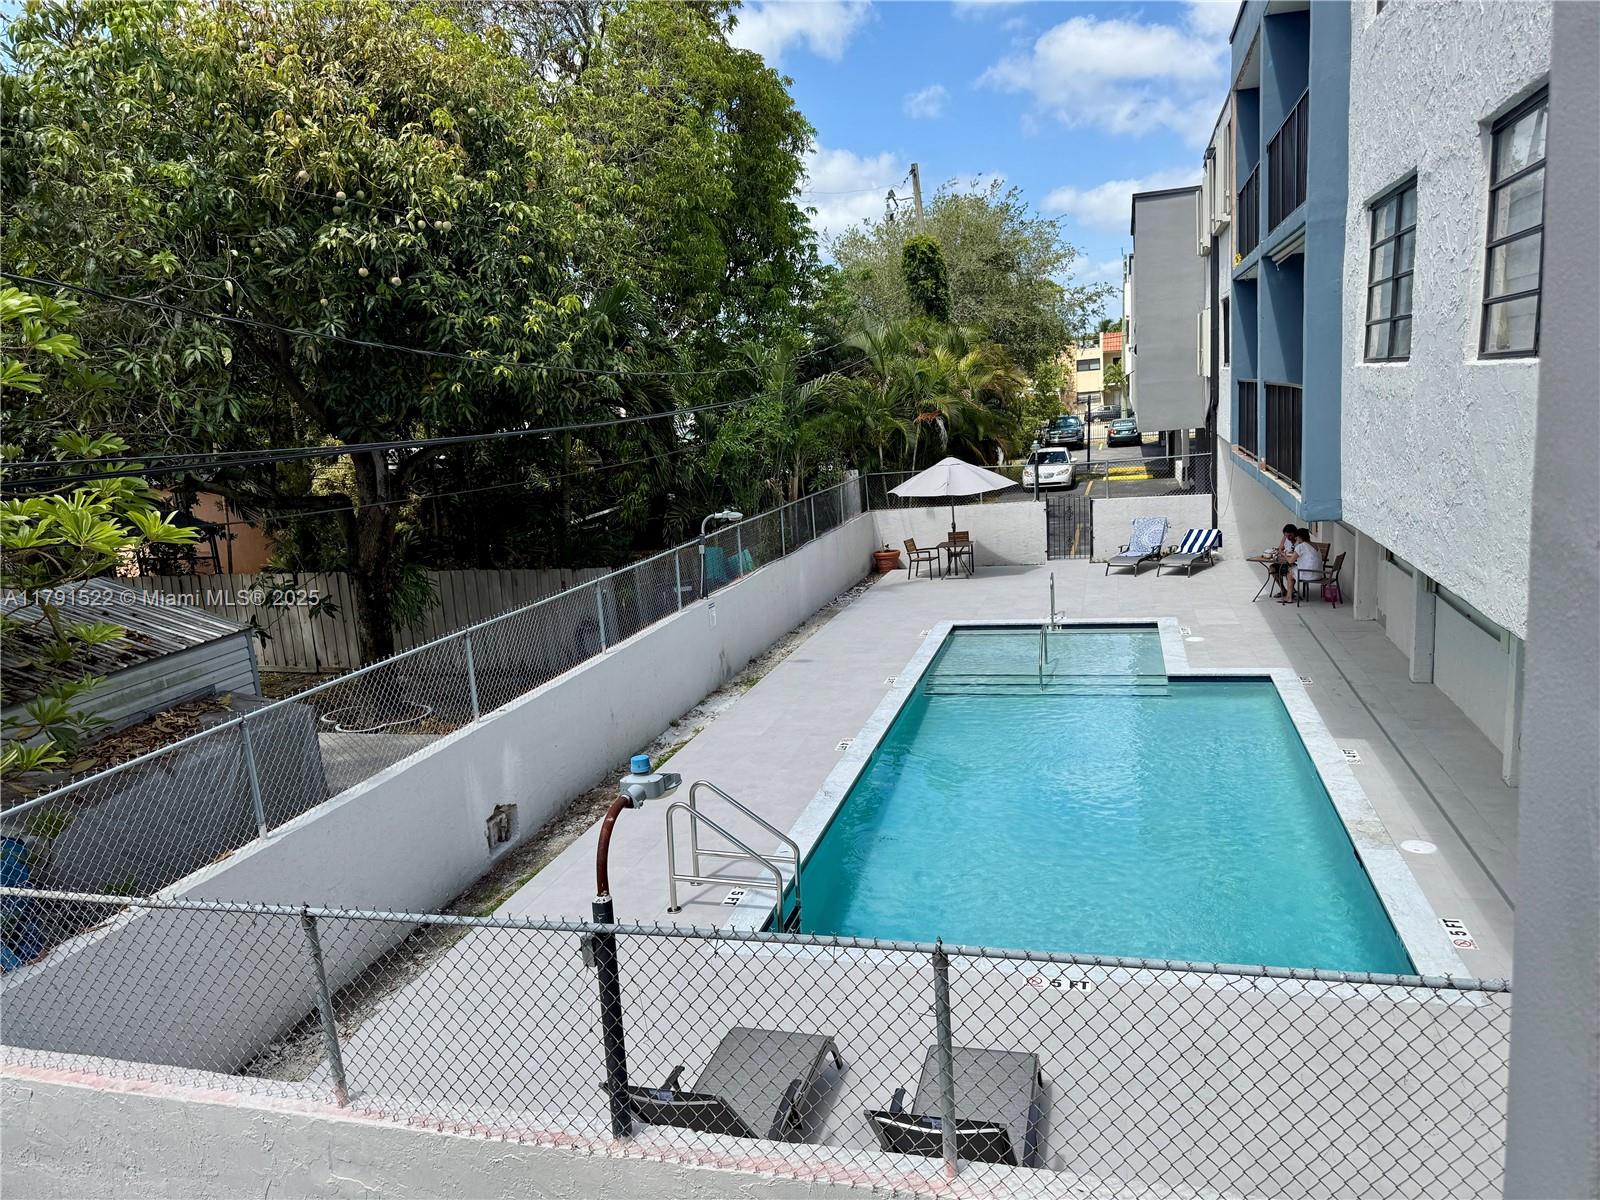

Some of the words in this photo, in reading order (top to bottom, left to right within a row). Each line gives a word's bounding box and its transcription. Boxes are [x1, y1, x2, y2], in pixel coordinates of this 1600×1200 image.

[723, 897, 740, 906] FT
[1442, 918, 1463, 929] FT
[1050, 979, 1062, 988] 5
[1069, 980, 1090, 990] FT
